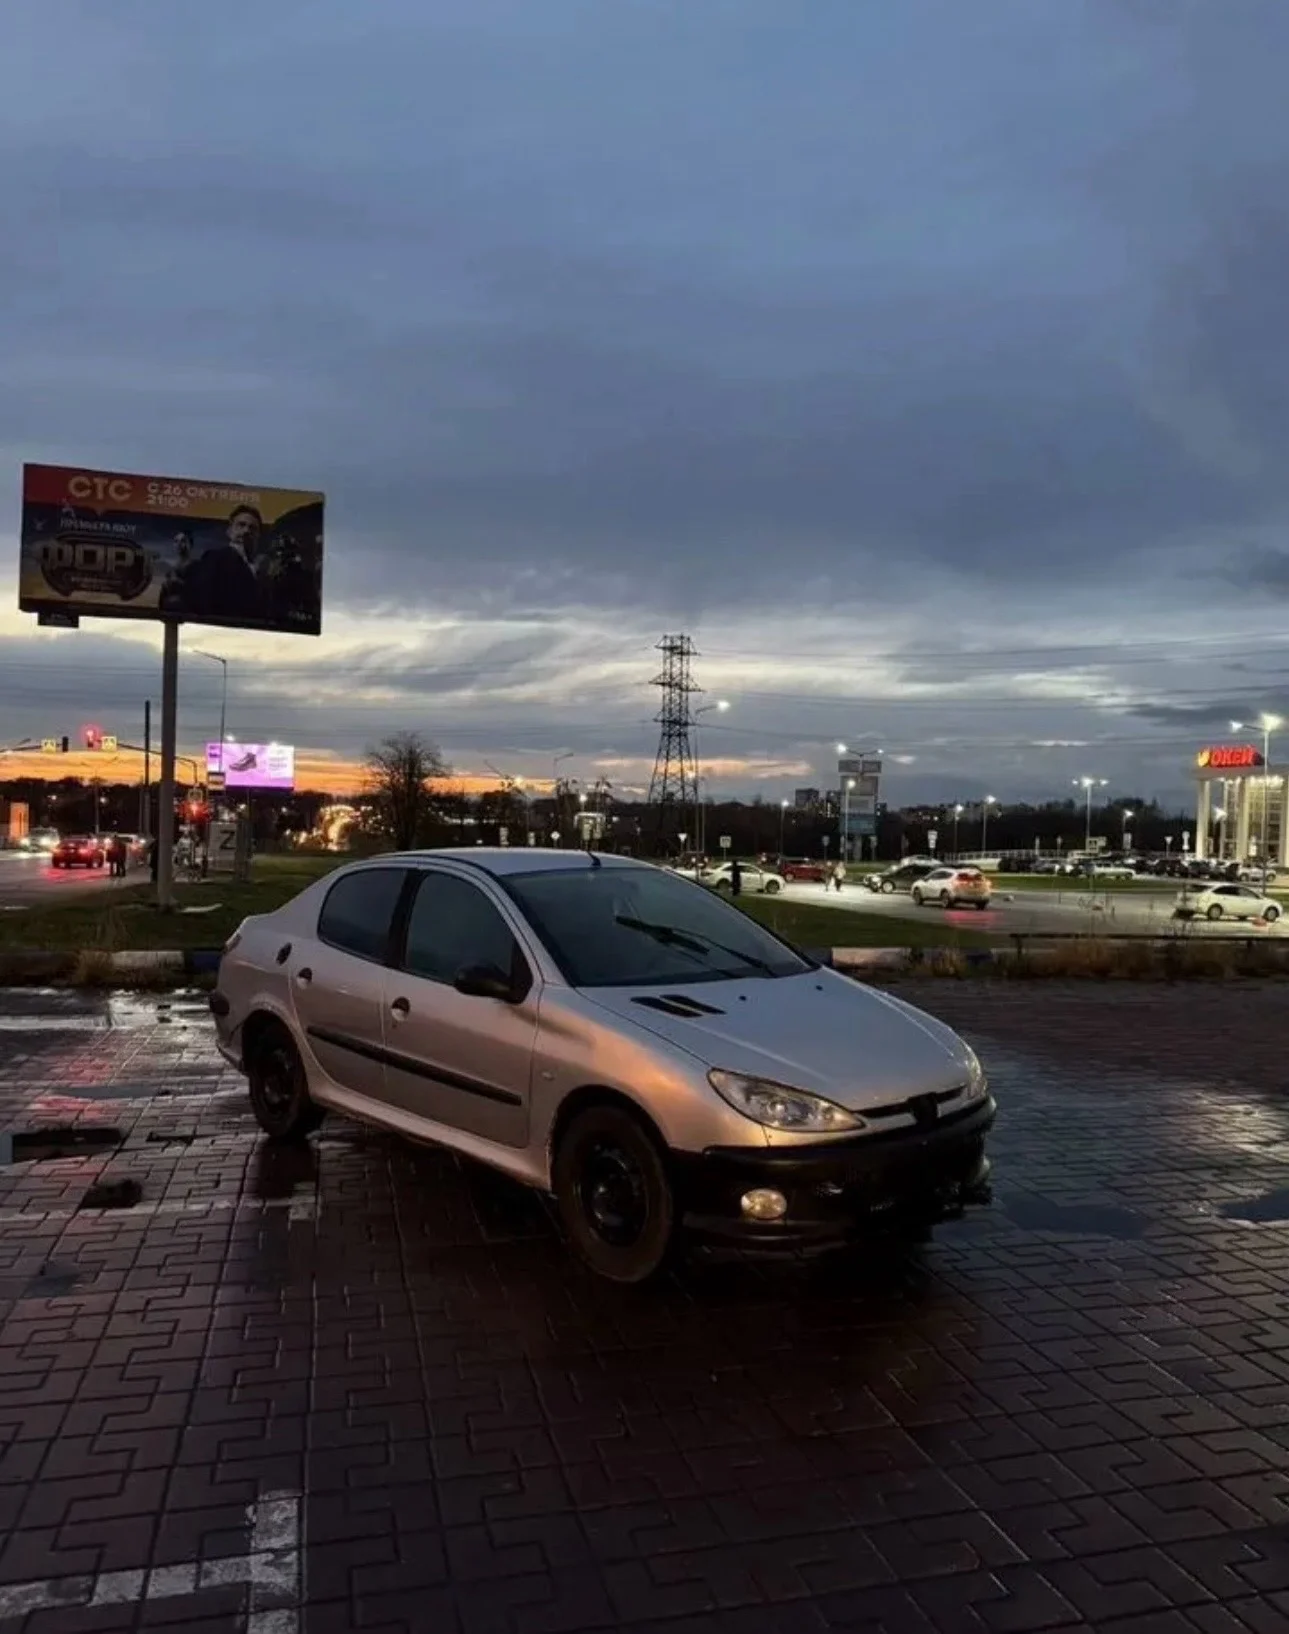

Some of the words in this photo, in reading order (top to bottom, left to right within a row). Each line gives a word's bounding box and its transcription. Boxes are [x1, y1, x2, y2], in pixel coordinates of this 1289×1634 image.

[67, 475, 133, 502] СТС
[147, 482, 160, 494] С
[163, 483, 182, 497] 26
[147, 494, 189, 509] 21:00
